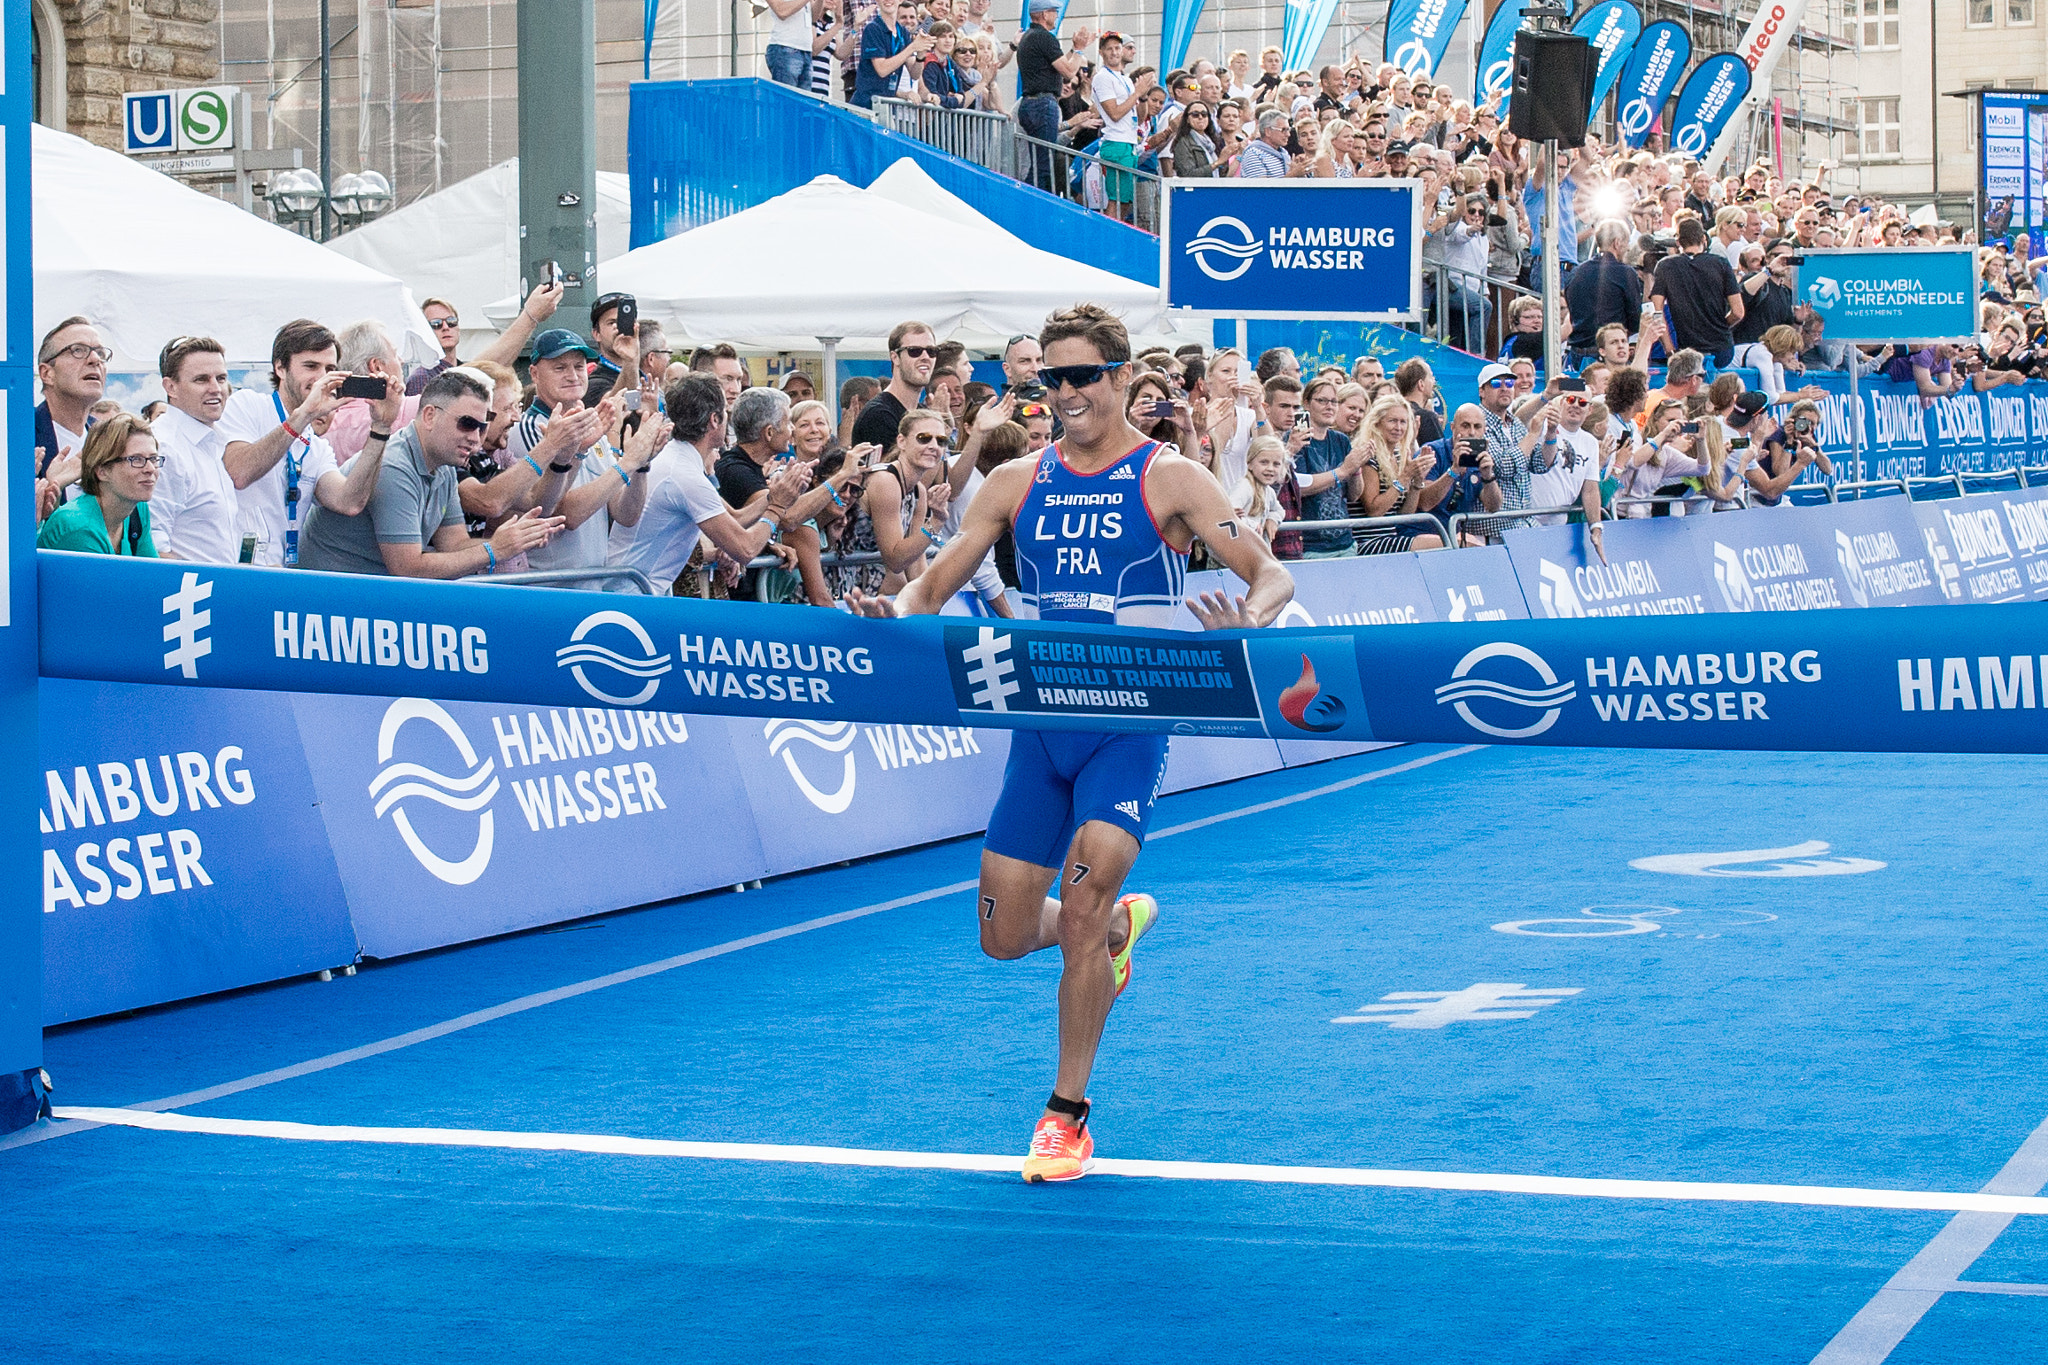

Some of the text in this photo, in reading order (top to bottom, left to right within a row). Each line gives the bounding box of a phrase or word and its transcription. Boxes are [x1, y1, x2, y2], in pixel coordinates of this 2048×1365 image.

[1597, 27, 1625, 77] ASSER
[1638, 29, 1671, 93] HAMBURG
[1647, 50, 1675, 97] WASSER
[1695, 61, 1733, 120] HAMBURG
[188, 95, 221, 141] S
[1703, 80, 1736, 123] WASSER
[133, 99, 166, 144] U
[1269, 227, 1395, 247] HAMBURG
[1270, 249, 1364, 269] WASSER
[1843, 279, 1923, 292] COLUMBIA
[1844, 292, 1965, 306] THREADNEEDLE
[1845, 309, 1903, 317] INVESTMENTS
[1871, 389, 1928, 449] ERDINGER
[1044, 493, 1124, 507] SHIMANO
[1035, 512, 1123, 541] LUIS
[1216, 520, 1239, 539] 7
[1943, 509, 2013, 567] ERDINGER
[1055, 547, 1102, 575] FRA
[1743, 543, 1809, 580] COLUMBIA
[1853, 530, 1901, 565] COLUMBIA
[1574, 559, 1661, 602] COLUMBIA
[1753, 577, 1841, 612] THREADNEEDLE
[1864, 558, 1932, 598] THREADNEEDLE
[274, 611, 489, 674] HAMBURG
[680, 634, 874, 675] HAMBURG
[1028, 640, 1224, 668] FEUER UND FLAMME
[684, 669, 834, 704] WASSER
[1030, 665, 1234, 689] WORLD TRIATHLON
[1585, 649, 1822, 688] HAMBURG
[1037, 688, 1150, 707] HAMBURG
[1590, 691, 1771, 722] WASSER
[492, 707, 689, 768] HAMBURG
[864, 723, 982, 771] WASSER
[511, 761, 667, 832] WASSER
[1069, 862, 1091, 886] 7
[983, 895, 997, 921] 7
